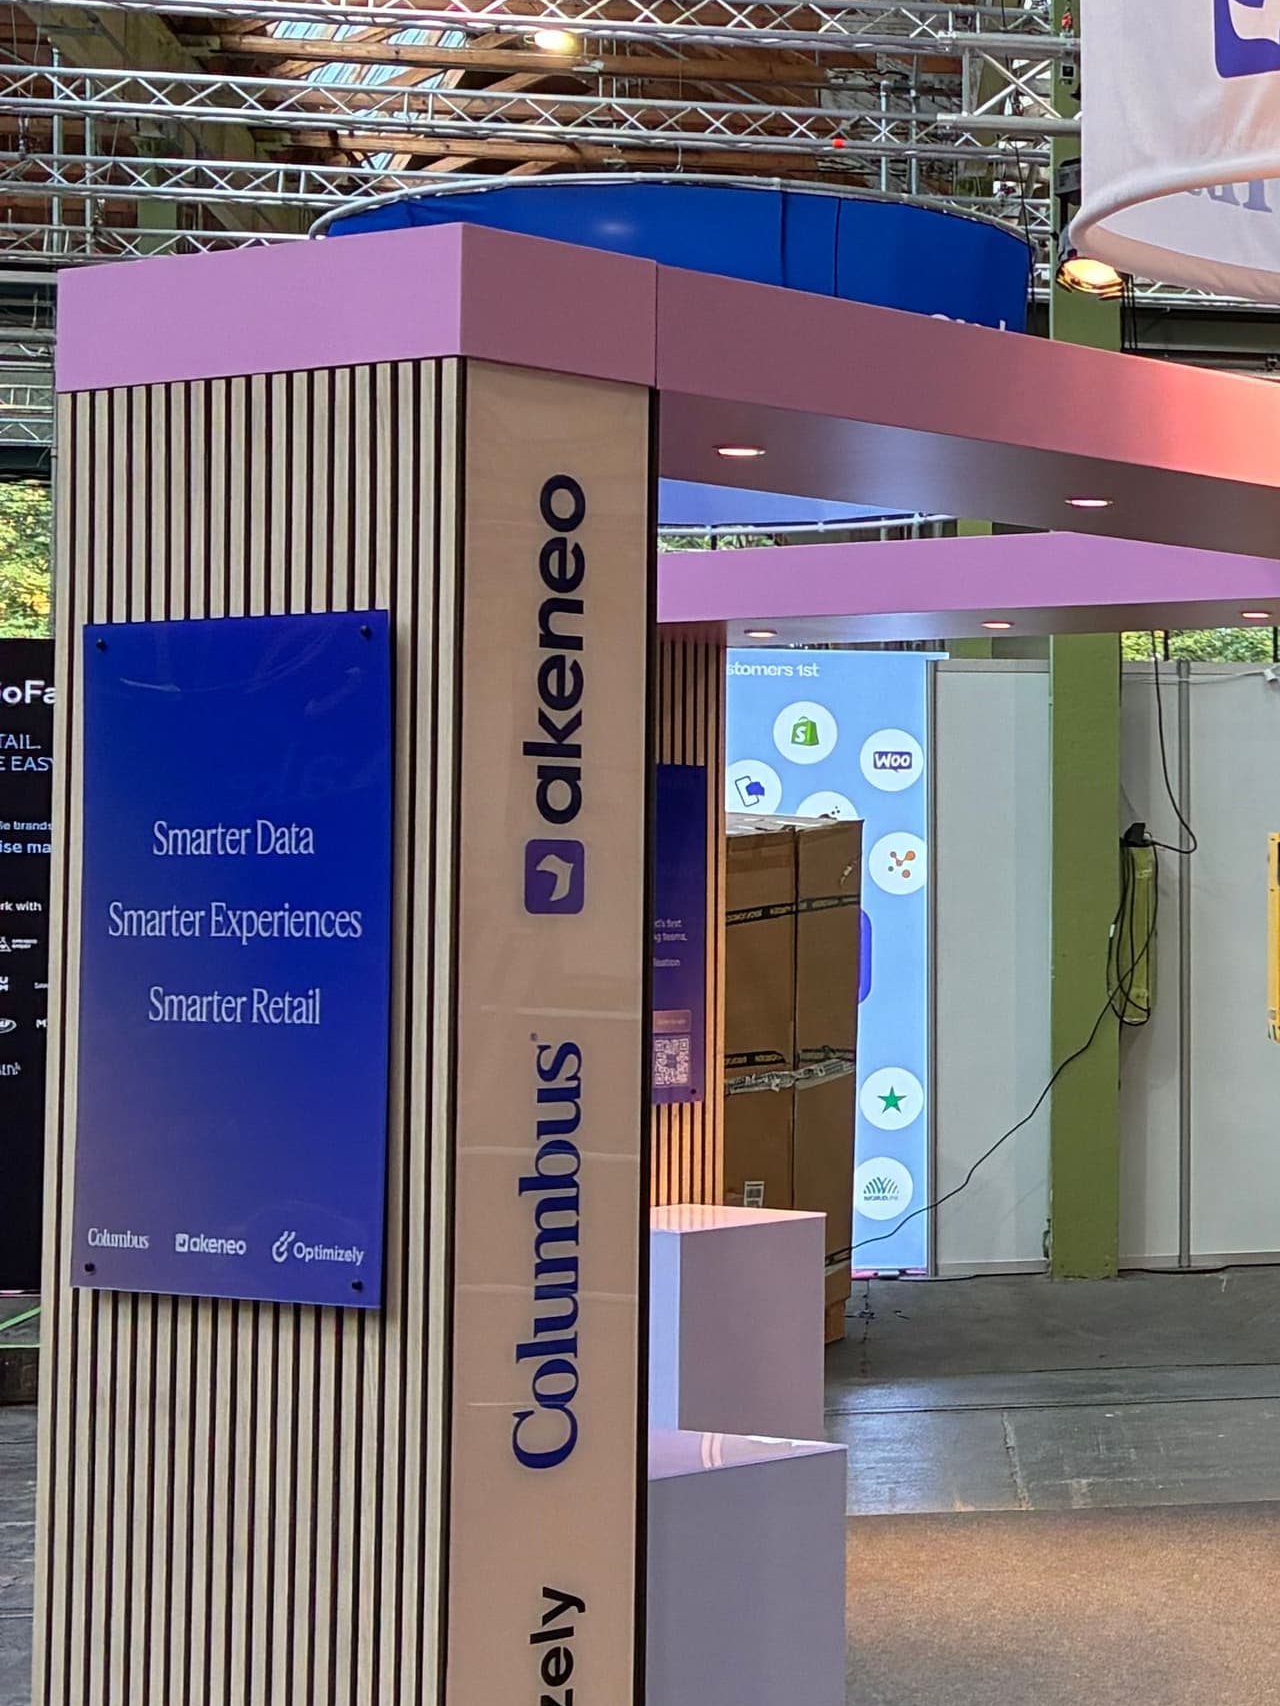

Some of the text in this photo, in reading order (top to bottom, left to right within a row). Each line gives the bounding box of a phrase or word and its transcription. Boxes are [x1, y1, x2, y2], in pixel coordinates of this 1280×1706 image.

[522, 474, 586, 825] akeneo
[726, 662, 820, 677] stomers 1st
[152, 819, 315, 856] Smarter Data
[108, 901, 363, 946] Smarter Experiences
[148, 985, 321, 1025] Smarter Retail
[88, 1227, 149, 1249] Columbus
[190, 1235, 247, 1255] akeneo
[293, 1241, 364, 1266] Optimizely
[511, 1039, 583, 1471] Columbus
